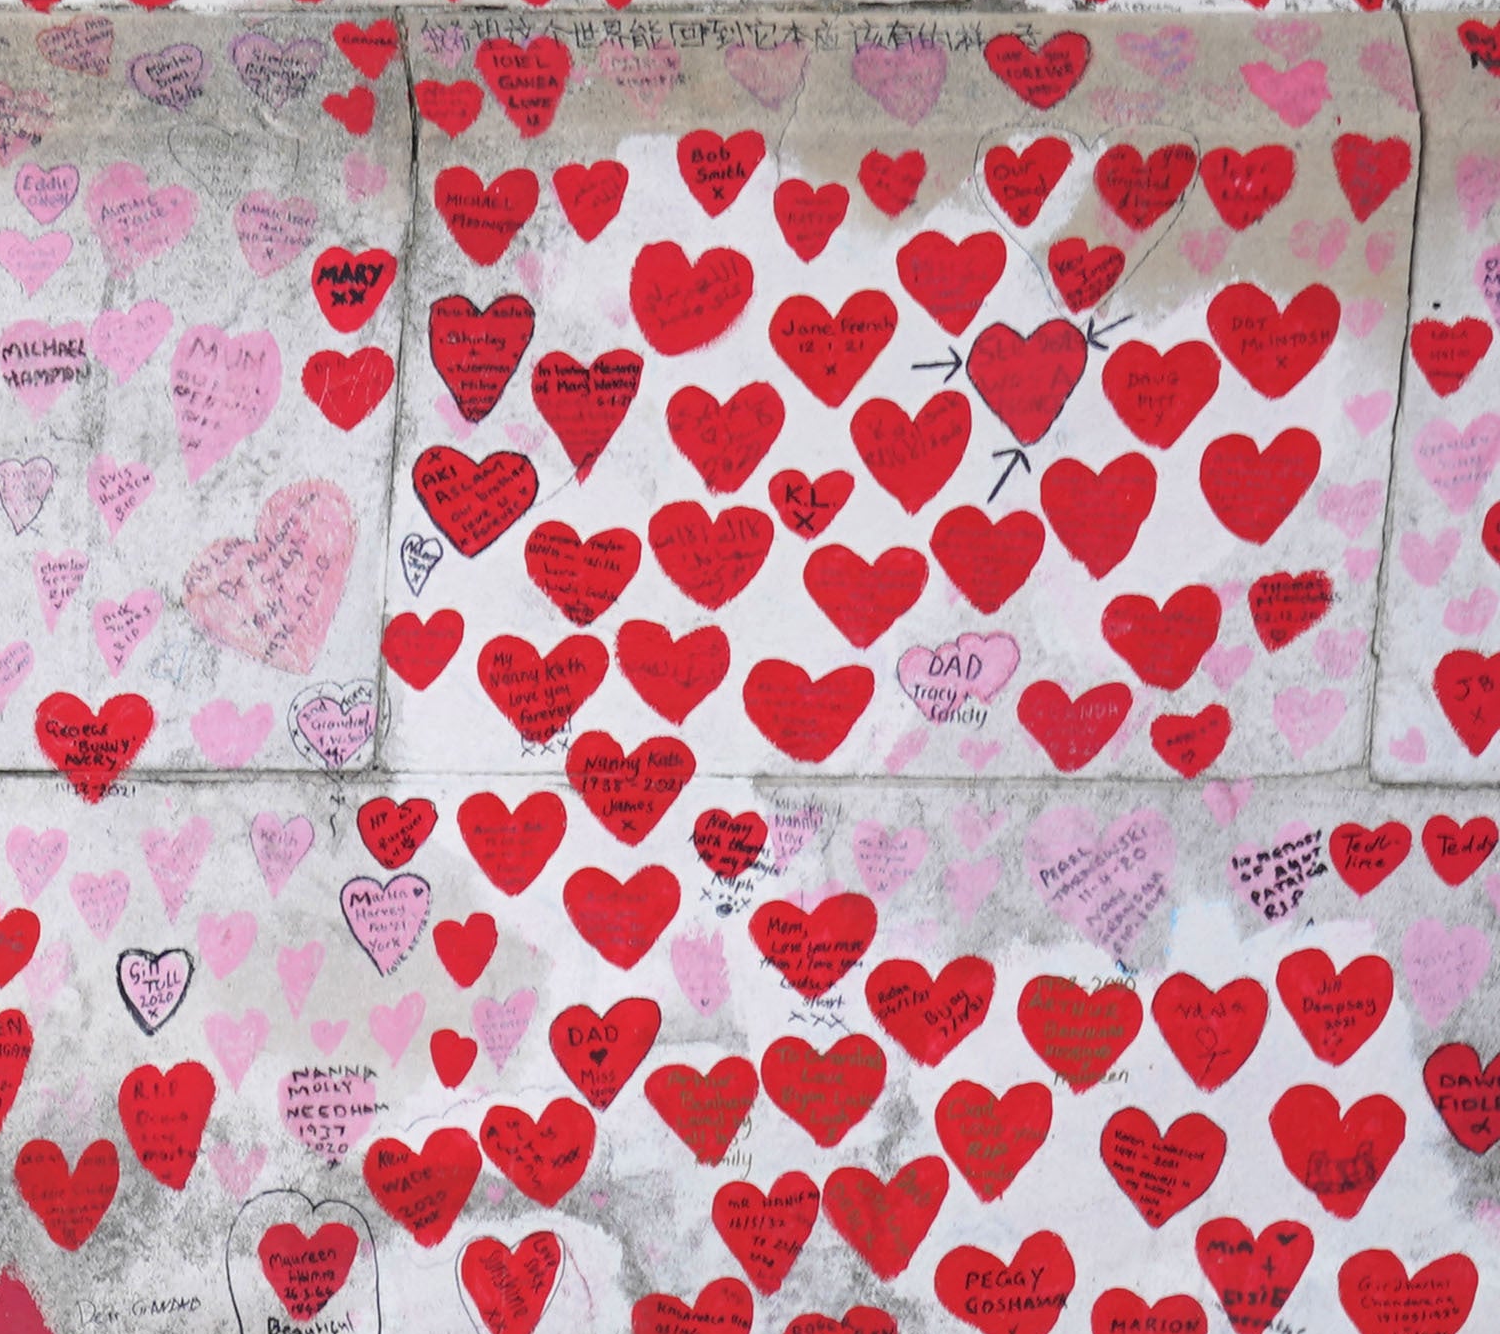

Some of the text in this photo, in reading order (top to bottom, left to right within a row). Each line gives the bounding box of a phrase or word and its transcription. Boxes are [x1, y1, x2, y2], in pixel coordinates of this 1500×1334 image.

[317, 262, 384, 287] MARY
[2, 339, 86, 361] MICHAEL
[3, 363, 92, 387] HAMPTON
[928, 655, 983, 680] DAD
[569, 1028, 618, 1047] DAD
[292, 1065, 377, 1082] NANNA
[288, 1080, 352, 1097] MOLLY
[286, 1102, 389, 1118] NEEDHAM
[965, 1266, 1044, 1290] PEGGY
[1110, 1319, 1201, 1333] MARION
